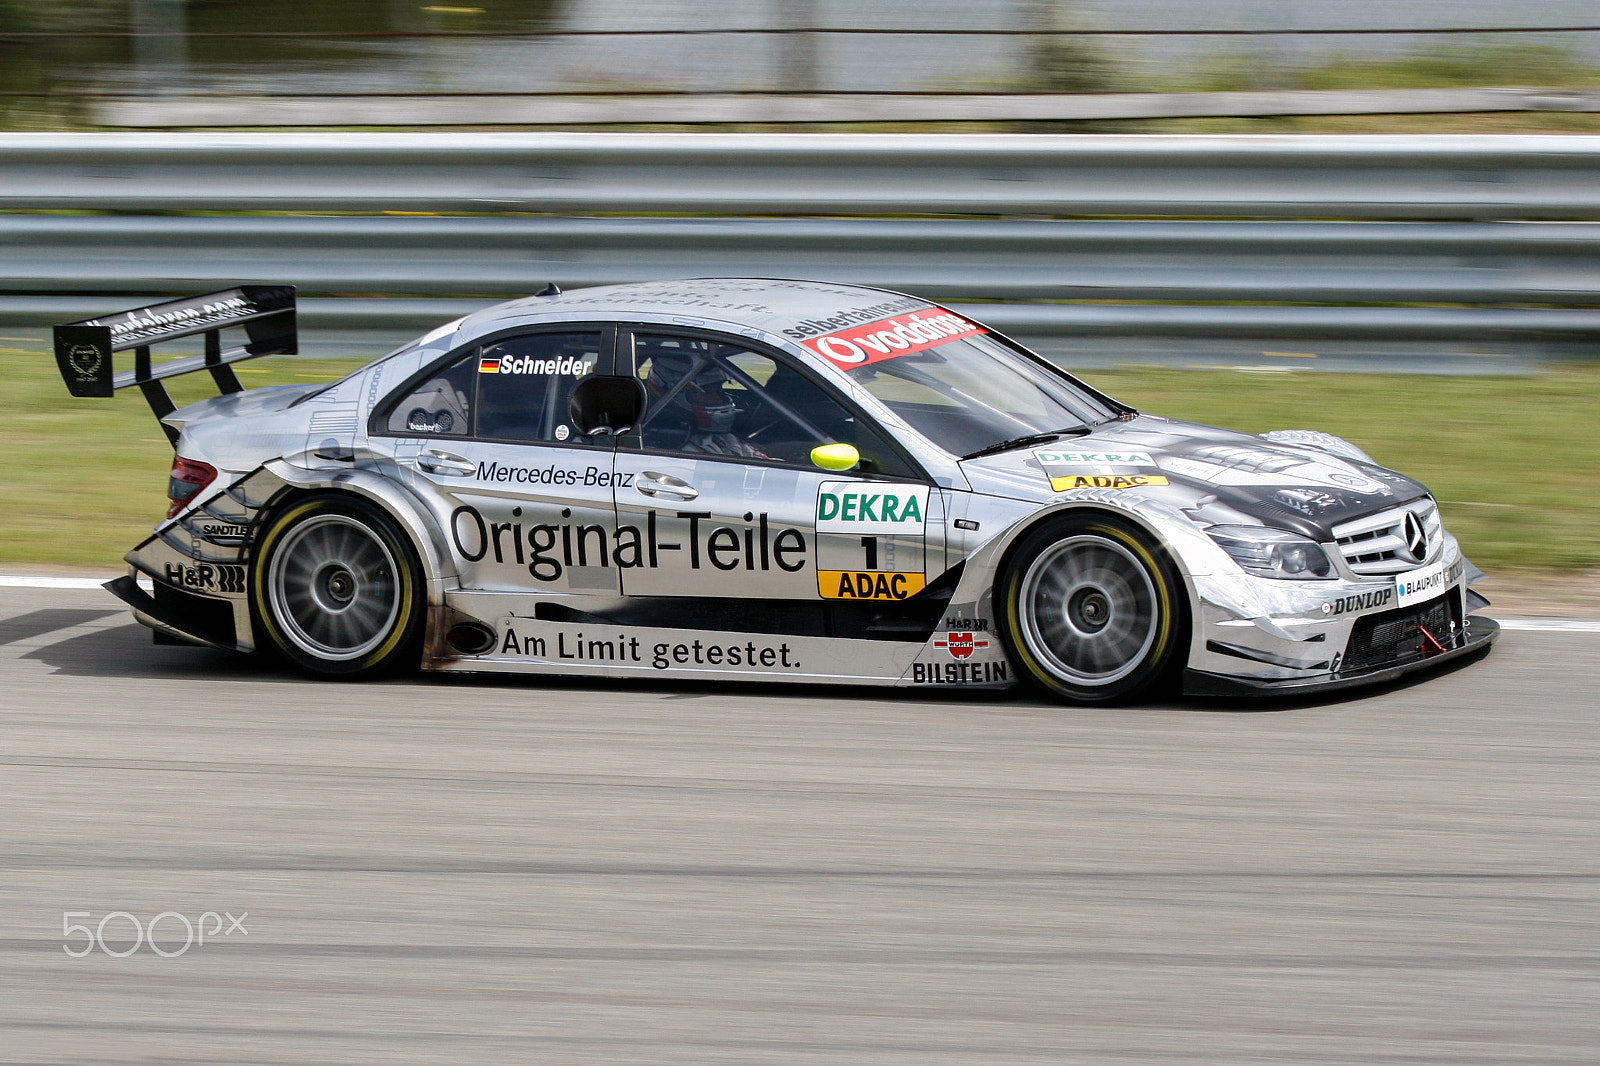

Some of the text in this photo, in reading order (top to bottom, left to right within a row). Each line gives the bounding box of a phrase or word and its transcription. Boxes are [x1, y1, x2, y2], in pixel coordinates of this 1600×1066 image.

[500, 354, 592, 376] Schneider
[1037, 453, 1150, 463] DEKRA
[476, 461, 636, 488] Mercedes-Benz
[1074, 476, 1149, 488] ADAC
[818, 493, 923, 523] DEKRA
[450, 505, 807, 582] Original-Teile
[861, 536, 878, 570] 1
[165, 563, 215, 588] H&R
[838, 573, 908, 599] ADAC
[1406, 571, 1443, 595] BLAUPUNKT
[1333, 588, 1391, 615] DUNLOP
[946, 618, 973, 629] H&R
[501, 628, 801, 669] Am Limit getestet.
[913, 661, 1007, 684] BILSTEIN
